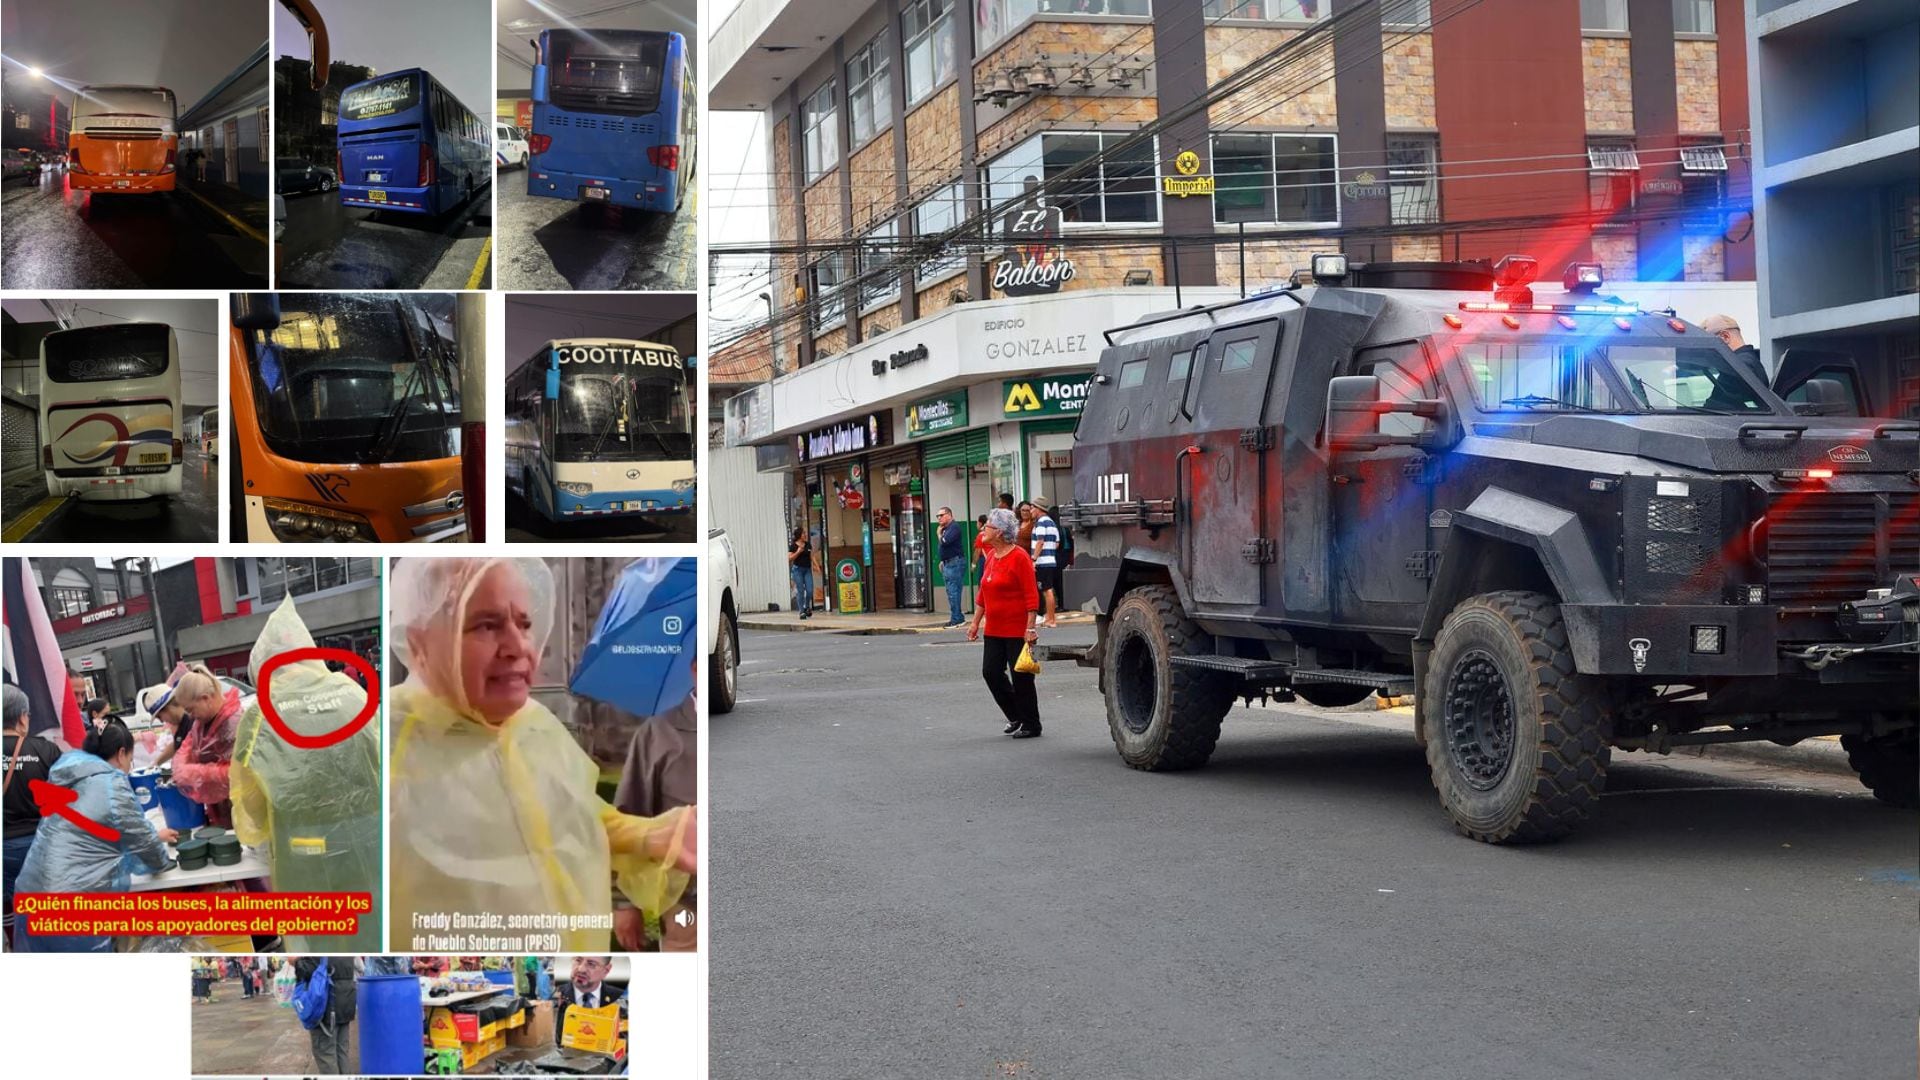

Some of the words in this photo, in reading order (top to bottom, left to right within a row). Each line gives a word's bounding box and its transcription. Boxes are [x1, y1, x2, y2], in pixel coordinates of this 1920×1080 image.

[1164, 177, 1214, 197] Imperial
[1013, 210, 1047, 232] El
[985, 319, 1025, 331] EDIFICIO
[986, 334, 1087, 359] GONZALEZ
[559, 347, 683, 370] COOTTABUS
[307, 697, 342, 714] Staff
